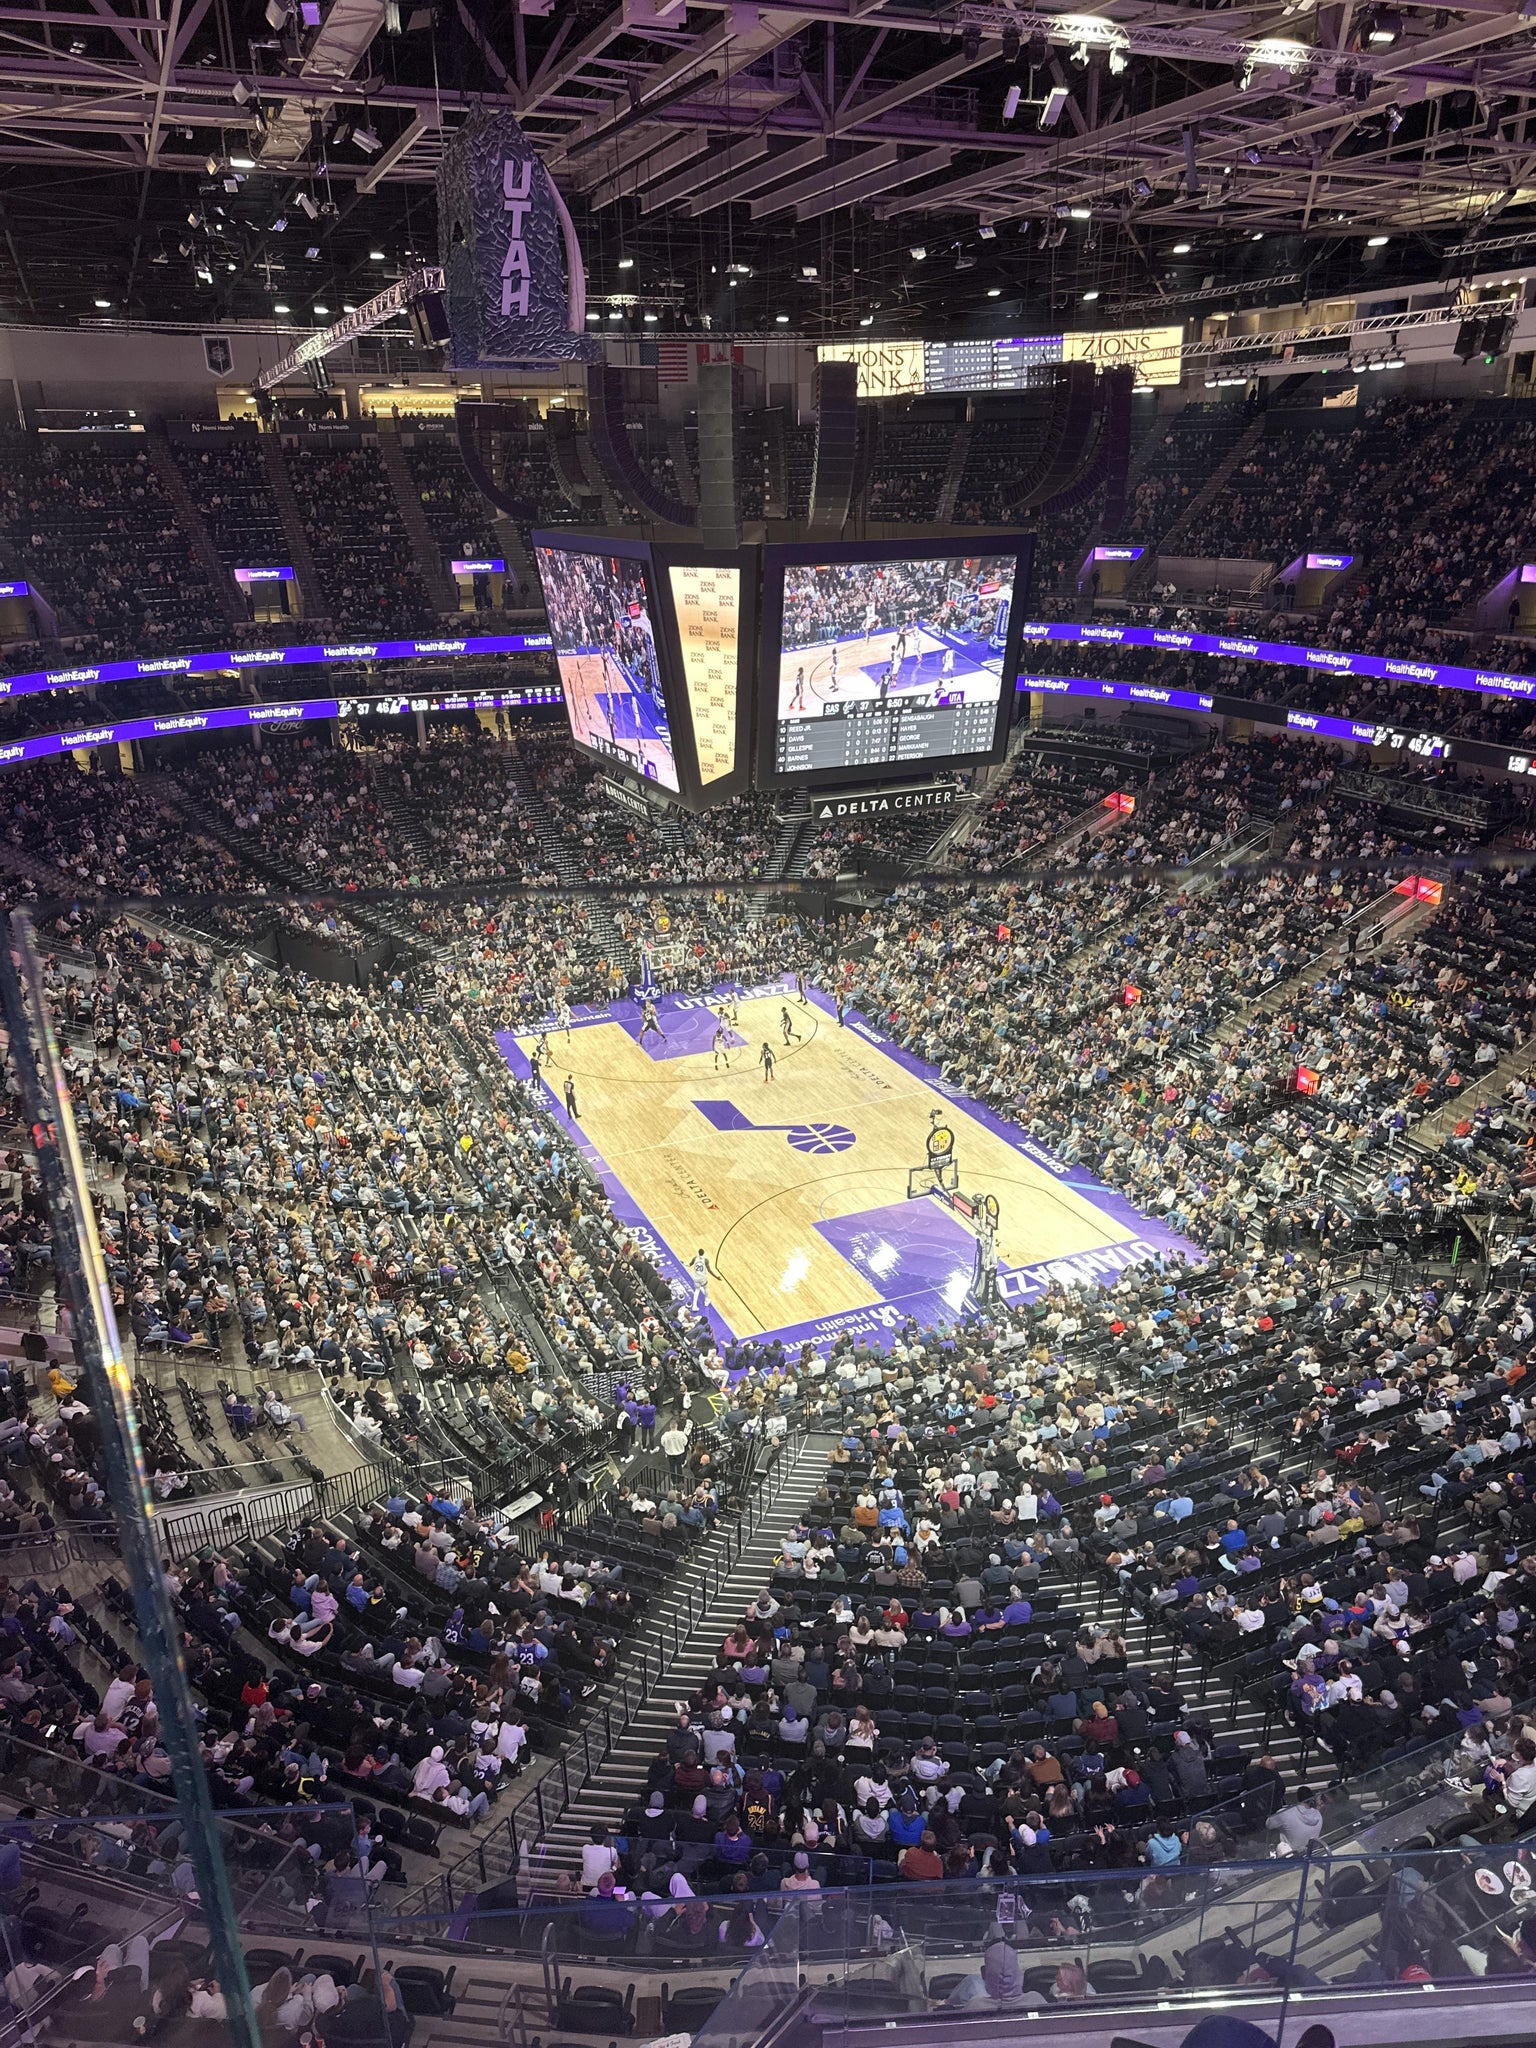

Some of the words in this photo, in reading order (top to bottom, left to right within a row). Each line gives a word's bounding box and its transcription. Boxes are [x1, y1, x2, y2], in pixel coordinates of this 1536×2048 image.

[501, 160, 531, 316] UTAH
[1081, 336, 1150, 357] ZIONS
[858, 370, 902, 389] ANK
[1081, 628, 1124, 640] HealthEquity
[1153, 632, 1193, 648] HealthEquity
[323, 645, 377, 658] HealthEquity
[414, 641, 466, 653] HealthEquity
[1219, 640, 1259, 655] HealthEquity
[230, 651, 285, 663] HealthEquity
[1306, 651, 1352, 668] HealthEquity
[137, 658, 192, 673] HealthEquity
[1385, 662, 1438, 680] HealthEquity
[47, 668, 100, 685] HealthEquity
[1475, 674, 1535, 694] HealthEquity
[1025, 678, 1070, 691] HealthEquity
[1130, 687, 1171, 702] HealthEquity
[357, 703, 369, 715] 37
[376, 702, 389, 714] 46
[825, 704, 840, 713] SAS
[860, 701, 869, 710] 37
[887, 698, 902, 708] 6:50
[916, 696, 926, 705] 46
[949, 694, 962, 702] UTA
[249, 707, 304, 719] HealthEquity
[154, 717, 208, 732] HealthEquity
[61, 730, 114, 746] HealthEquity
[1390, 734, 1404, 748] 37
[1408, 737, 1422, 751] 46
[788, 744, 813, 752] GILLESPIE
[609, 786, 628, 804] DELTA
[627, 796, 648, 816] CENTER
[837, 799, 889, 815] DELTA
[894, 791, 951, 808] CENTER
[674, 993, 735, 1010] UTAH
[740, 983, 796, 1000] JAZZ
[1017, 1140, 1072, 1175] SEATGEEK
[686, 1180, 712, 1204] DELTA
[815, 1311, 870, 1332] Health
[474, 1555, 480, 1568] 3
[446, 1628, 458, 1643] 23
[520, 1653, 534, 1664] 23
[124, 1716, 140, 1730] 12
[748, 1815, 765, 1830] 24
